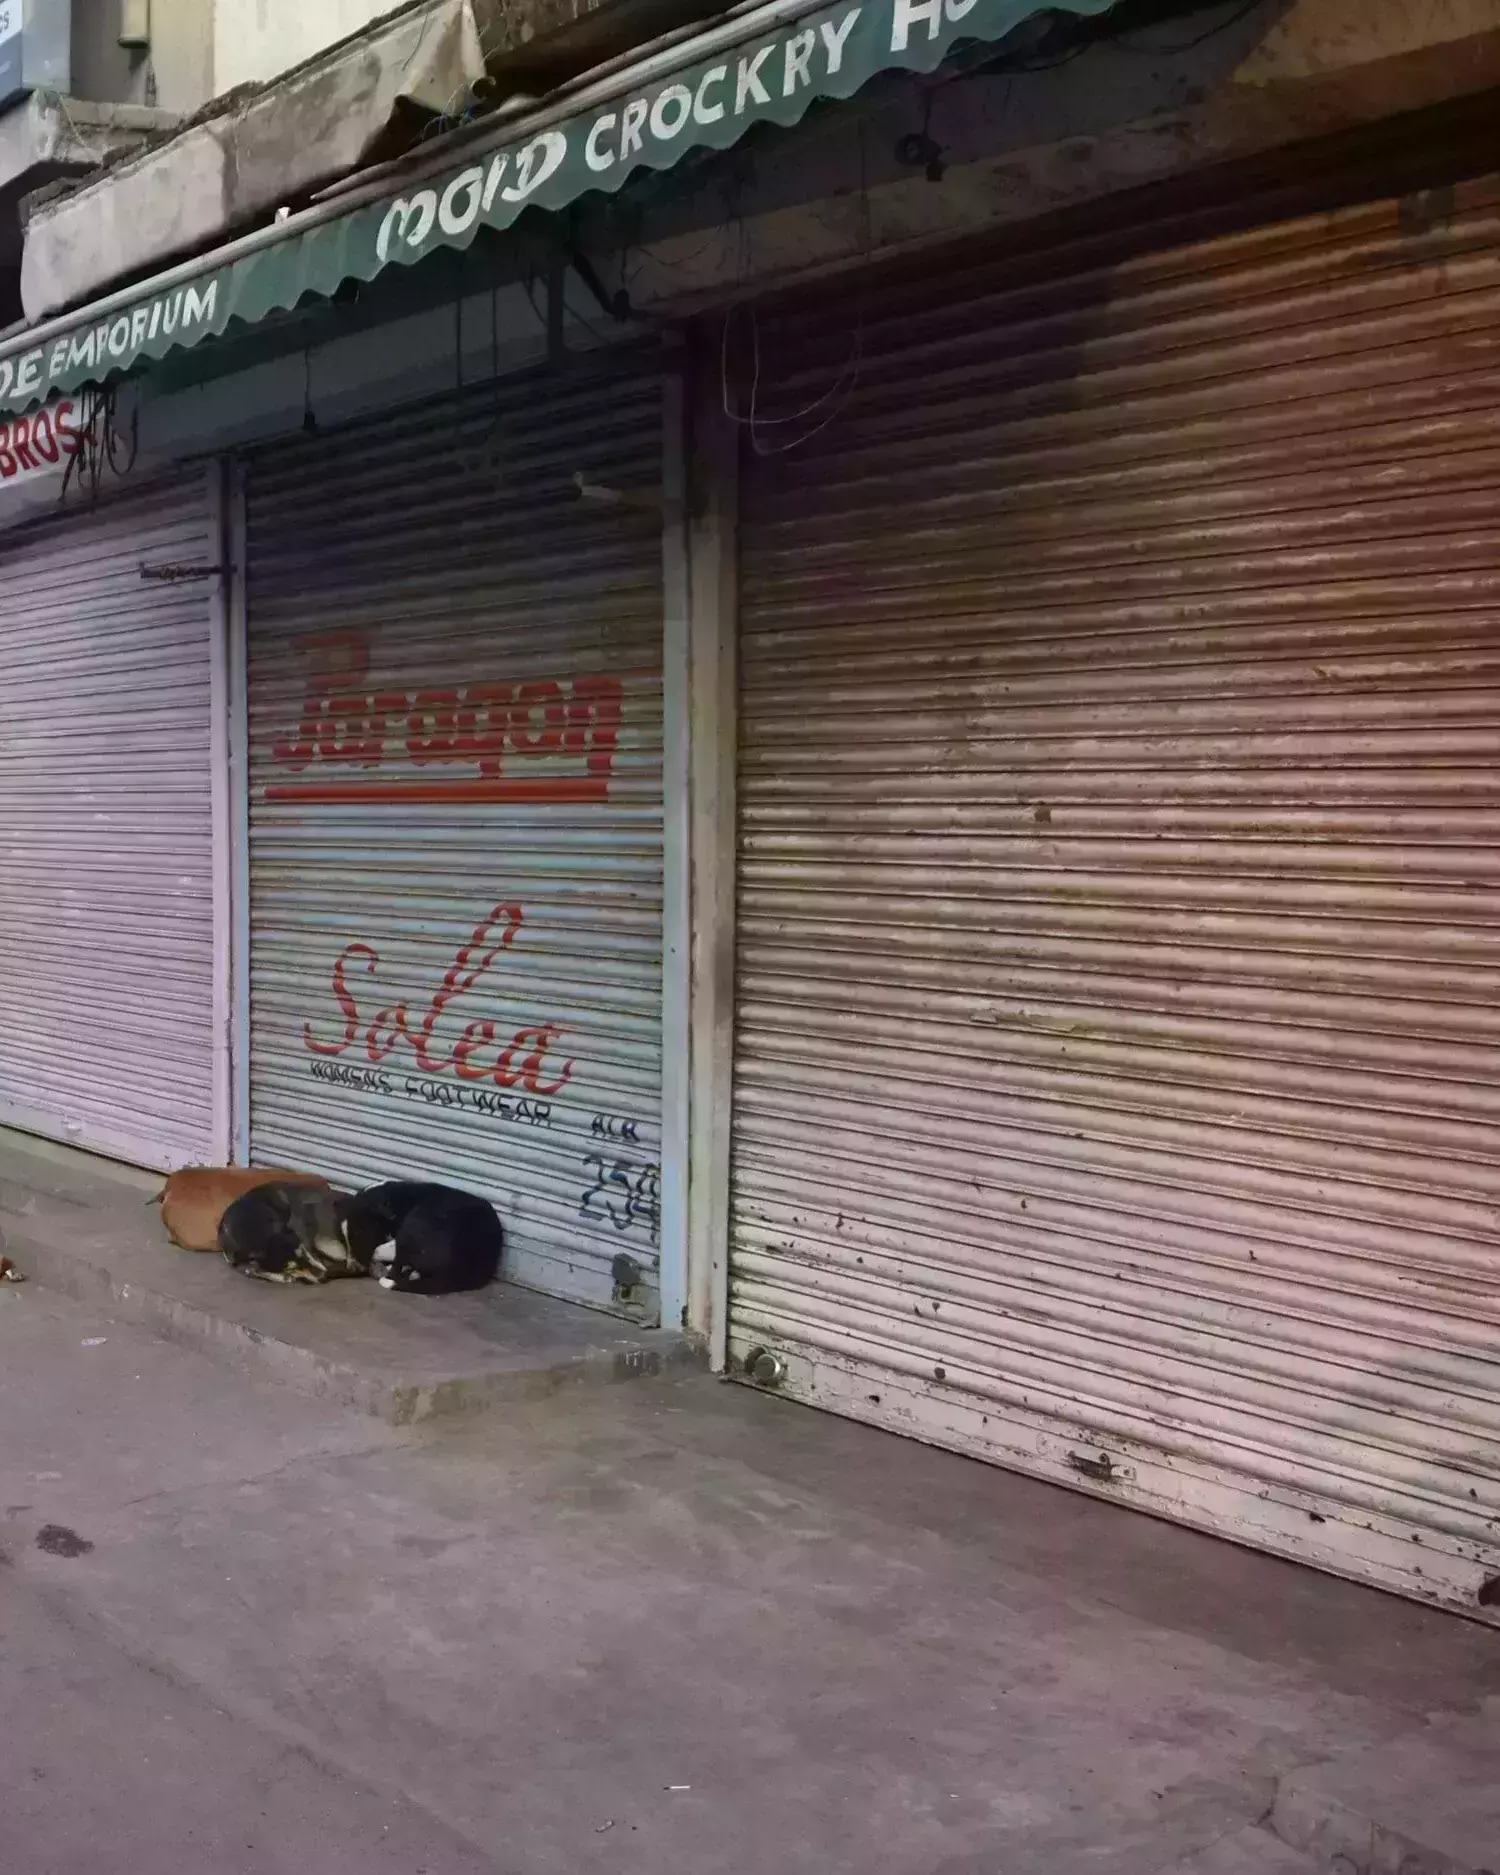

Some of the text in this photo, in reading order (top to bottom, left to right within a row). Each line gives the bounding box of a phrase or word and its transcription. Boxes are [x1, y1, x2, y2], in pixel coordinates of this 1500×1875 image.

[584, 8, 859, 172] CROCKRY
[47, 279, 218, 379] EMPORIUM
[303, 901, 576, 1094] Solea
[404, 1074, 551, 1127] FOOTWEAR
